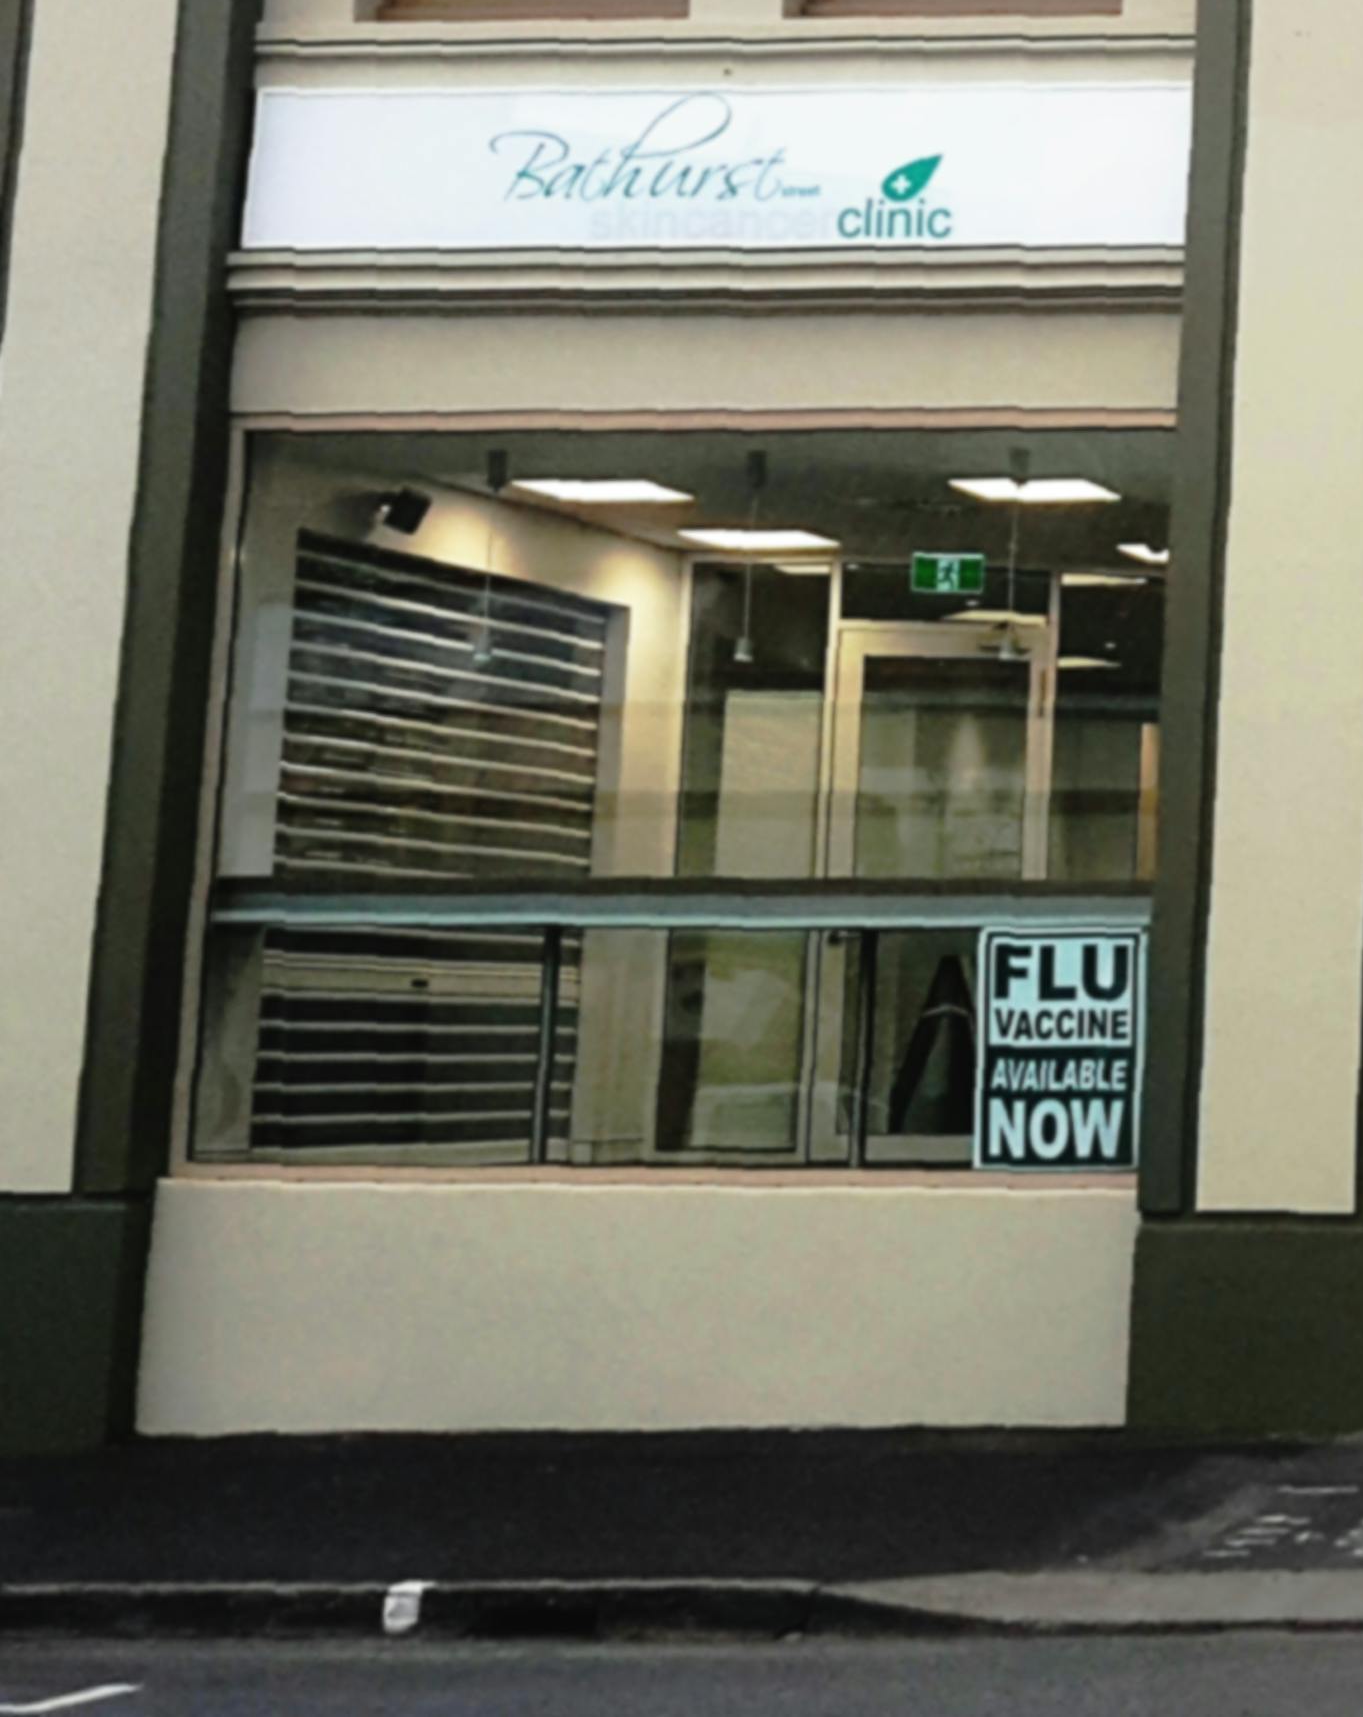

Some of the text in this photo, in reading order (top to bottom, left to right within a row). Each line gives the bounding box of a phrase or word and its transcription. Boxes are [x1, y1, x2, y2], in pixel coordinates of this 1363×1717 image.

[489, 92, 785, 202] Bathurst
[994, 944, 1130, 1001] FLU
[994, 1008, 1129, 1041] VACCINE
[990, 1057, 1129, 1092] AVAILABLE
[988, 1098, 1124, 1159] NOW
